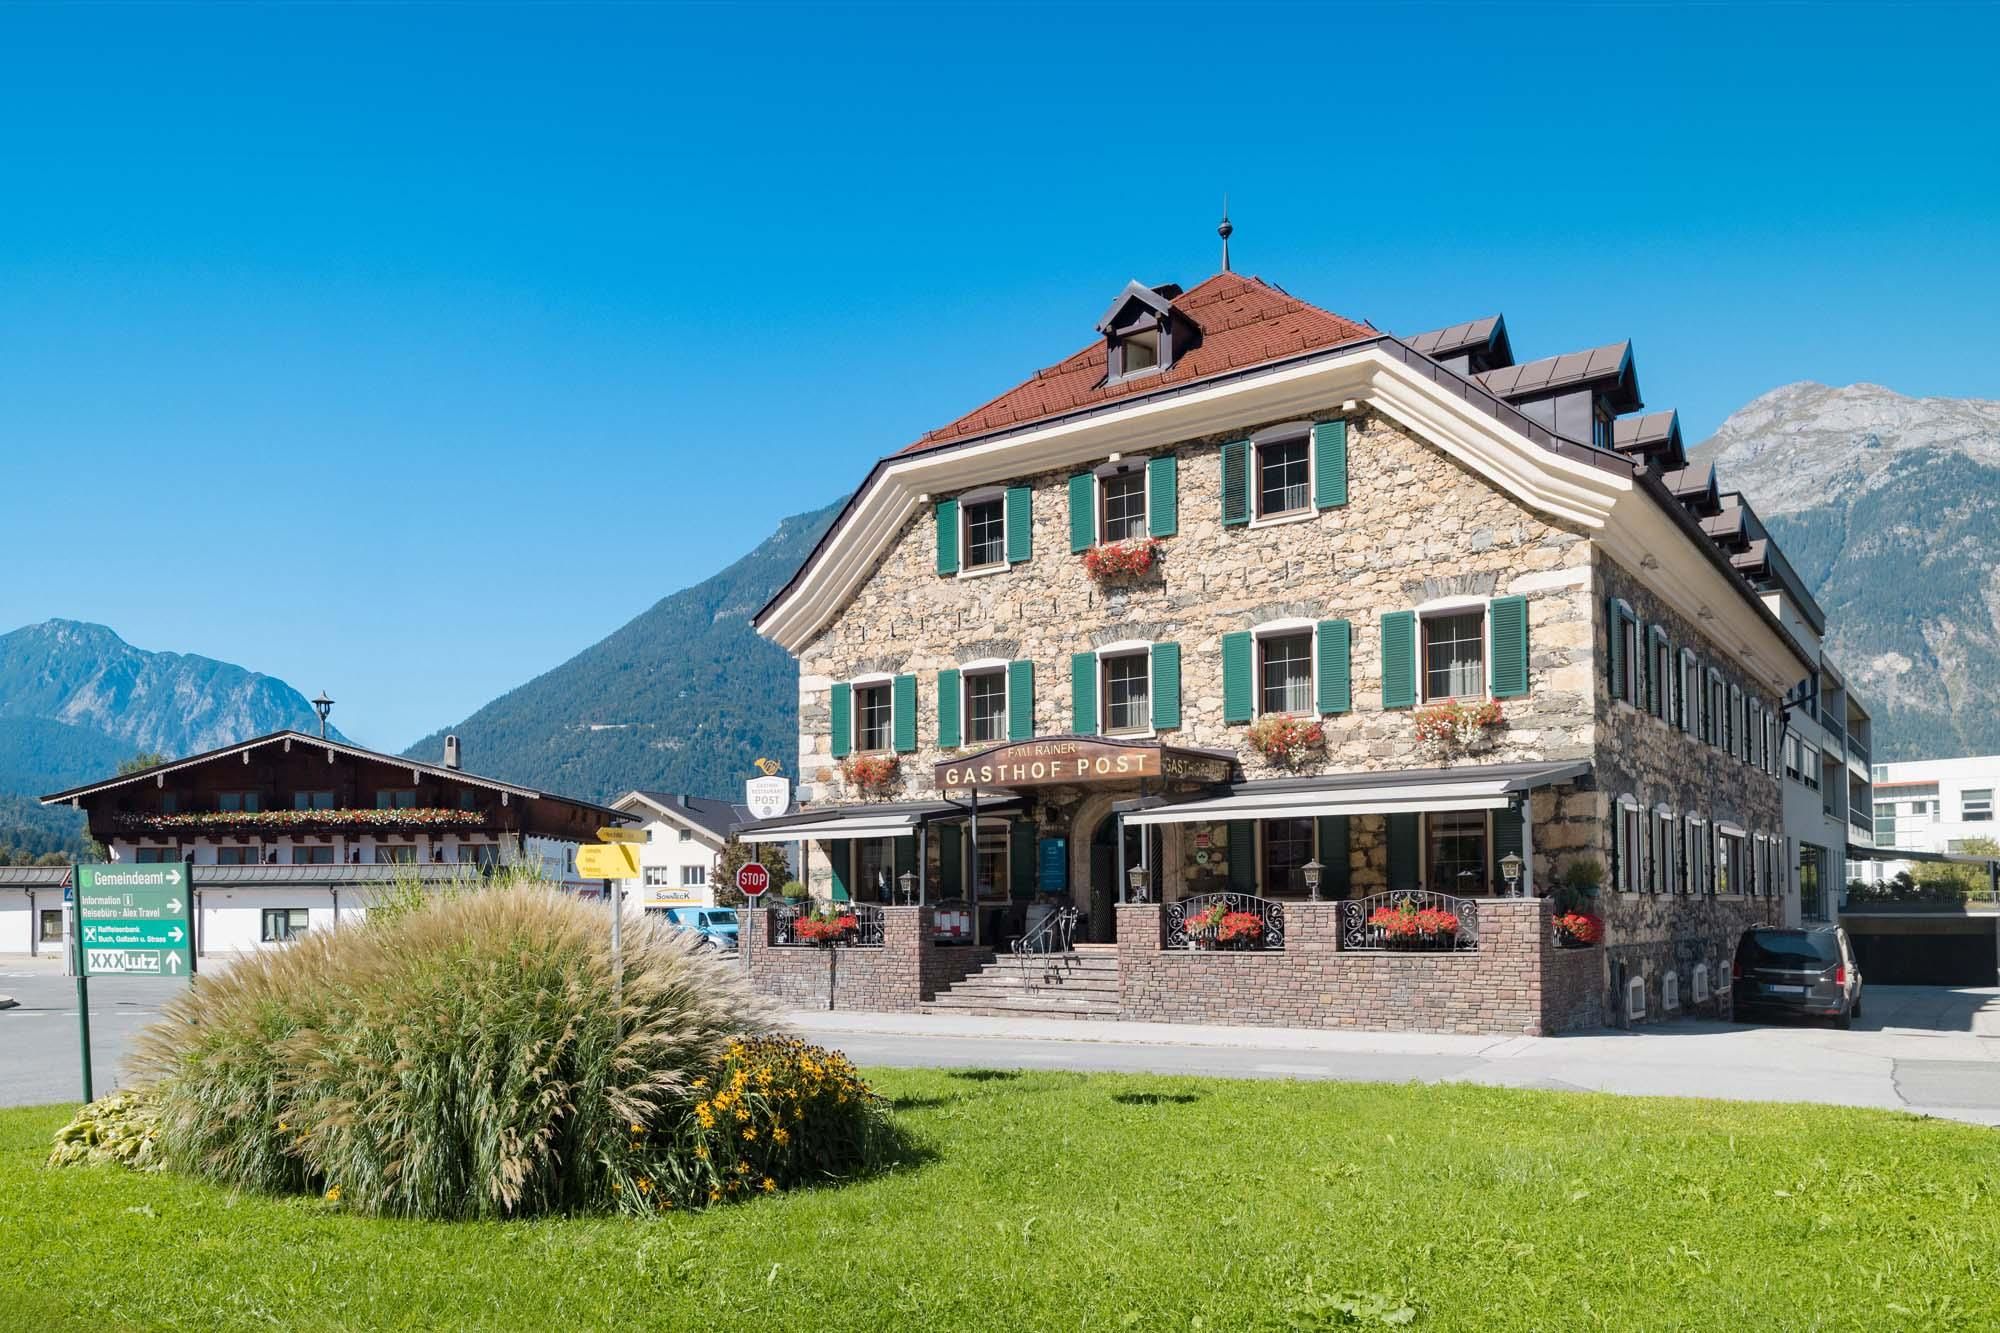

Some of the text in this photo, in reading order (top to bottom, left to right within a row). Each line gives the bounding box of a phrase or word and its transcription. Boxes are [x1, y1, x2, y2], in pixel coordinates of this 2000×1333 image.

[1035, 742, 1076, 756] RAINER
[946, 754, 1148, 785] GASTHOF POST
[755, 795, 780, 805] POST
[94, 871, 164, 886] Gemeindeamt
[741, 872, 766, 886] STOP
[82, 896, 121, 905] Information
[82, 908, 117, 918] Reisebüro
[123, 908, 137, 917] Alex
[137, 907, 160, 918] Travel
[91, 953, 158, 969] XXXLutz
